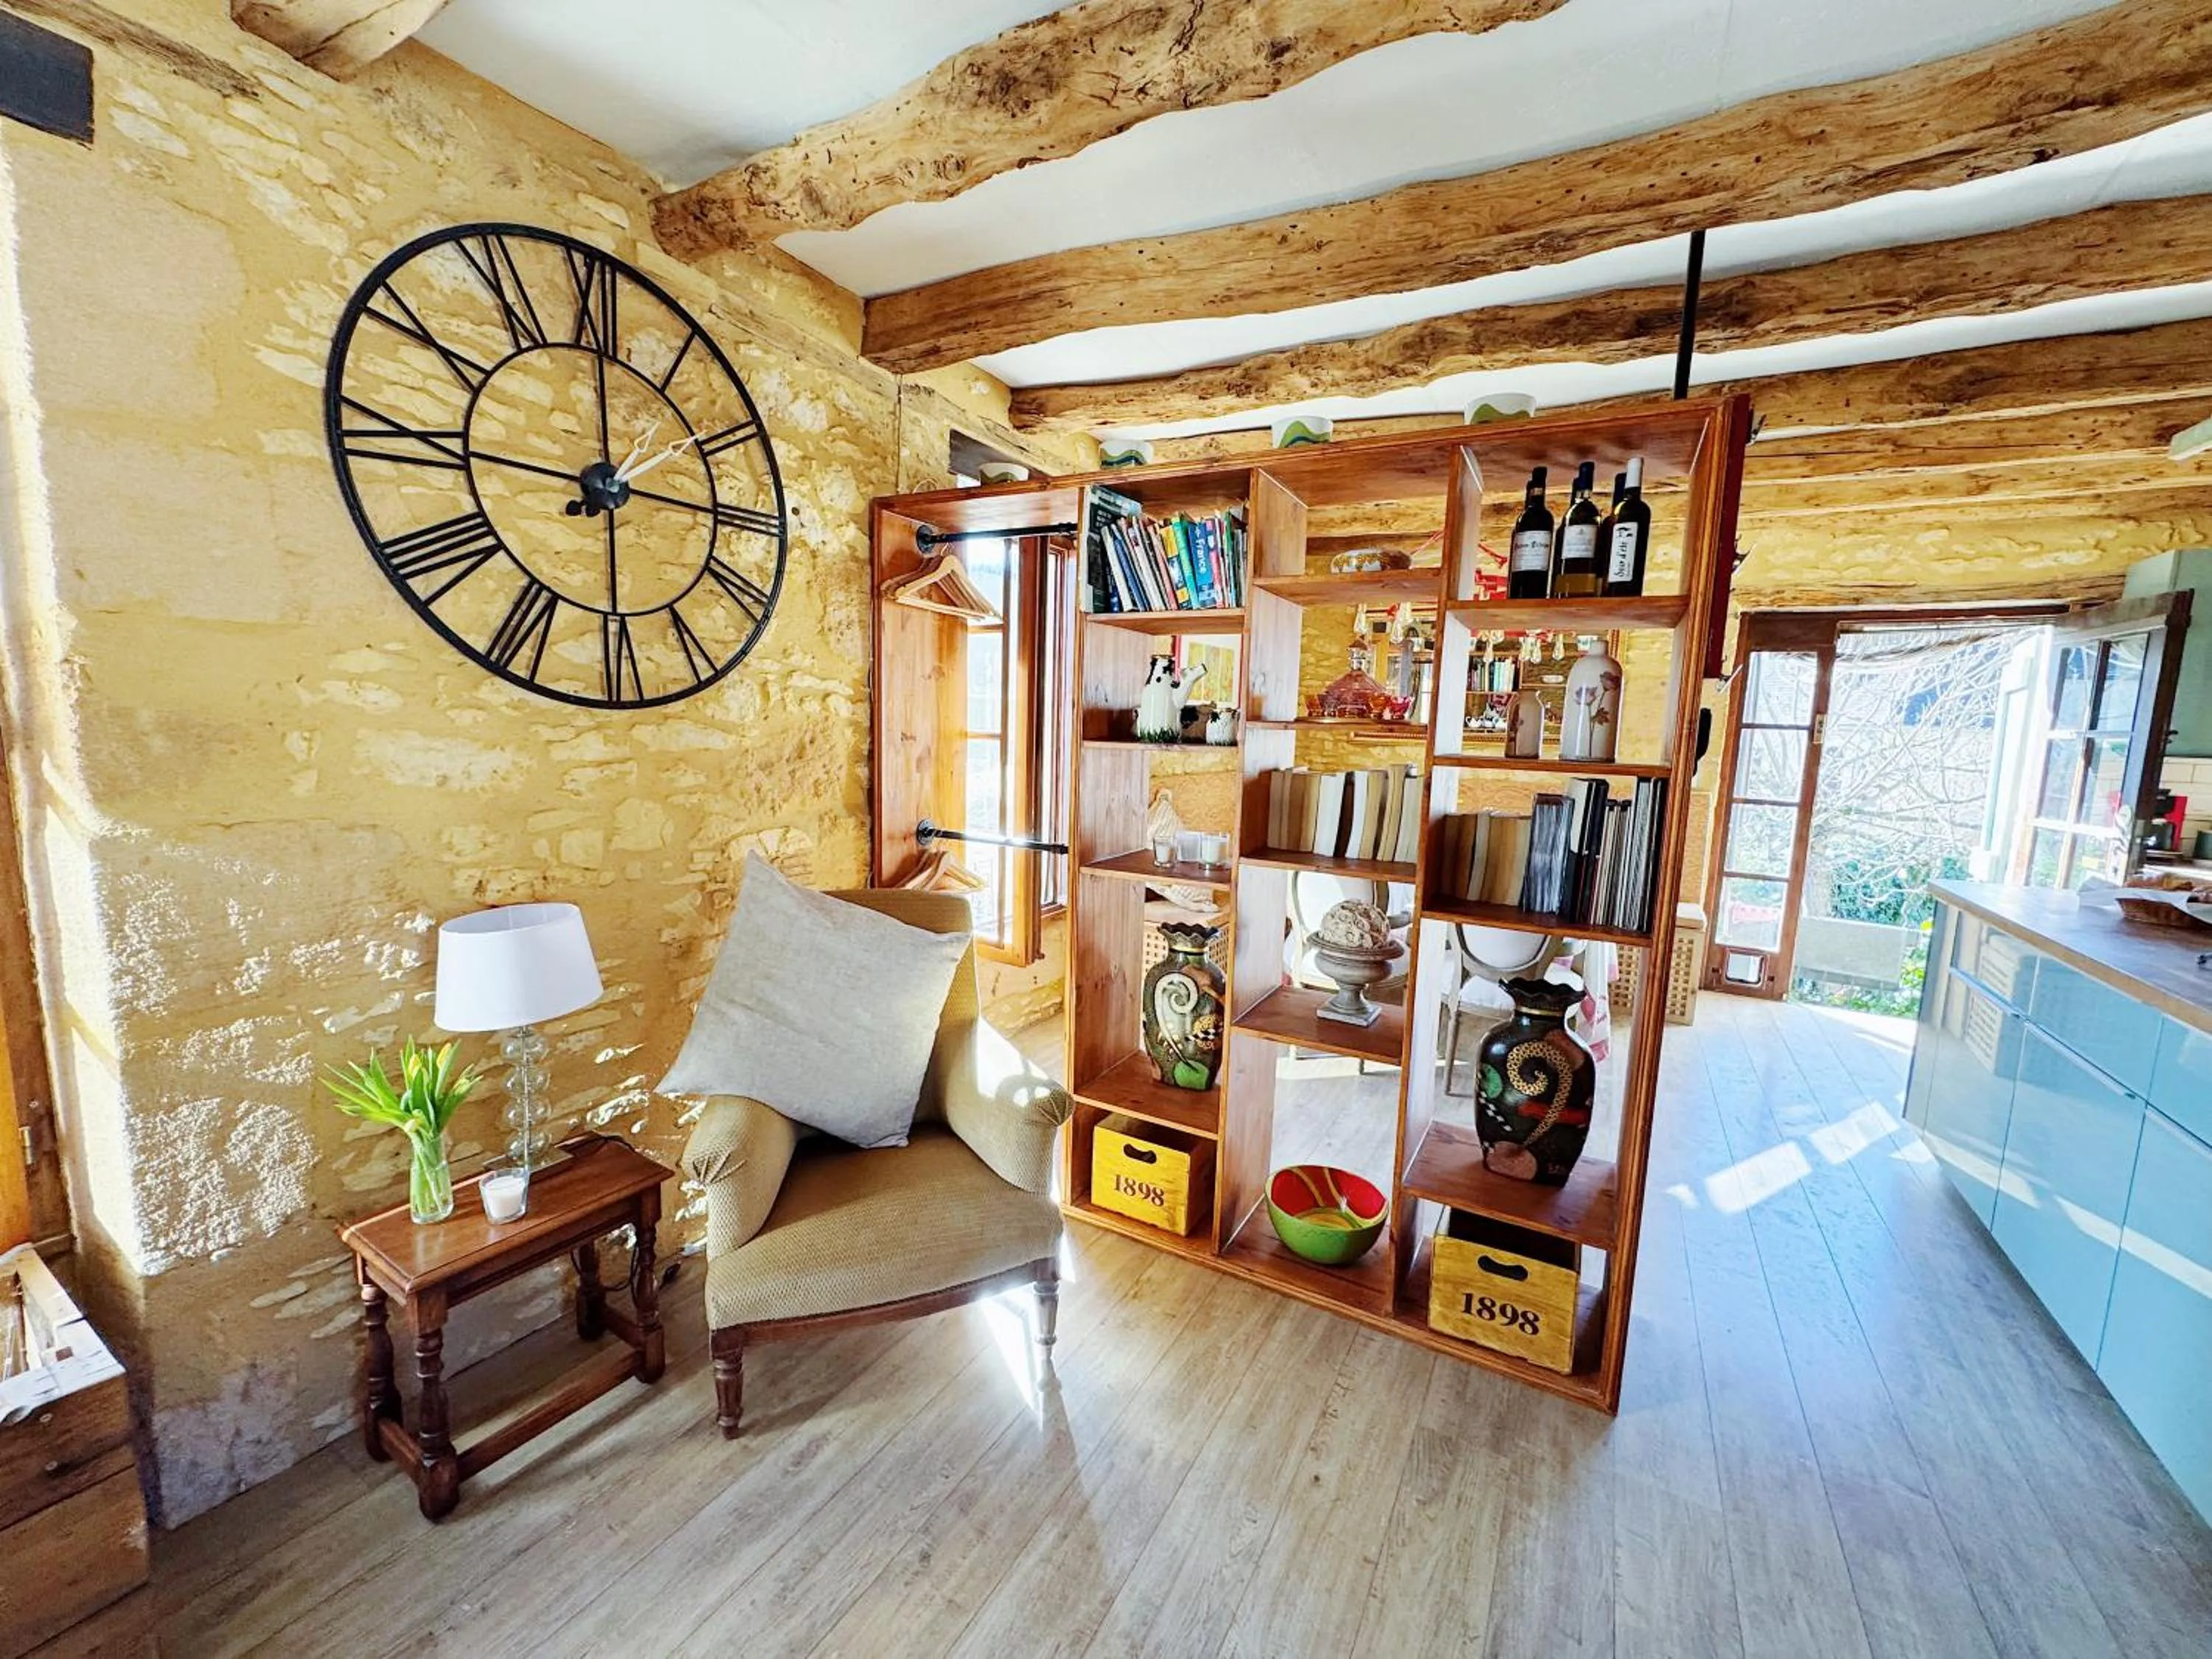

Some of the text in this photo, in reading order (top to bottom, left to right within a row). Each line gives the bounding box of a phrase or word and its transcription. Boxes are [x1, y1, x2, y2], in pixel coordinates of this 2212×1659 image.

[566, 246, 617, 359] XII
[365, 281, 490, 392] X
[1196, 538, 1207, 574] France
[1115, 1174, 1164, 1207] 1898
[1462, 1293, 1540, 1335] 1898
